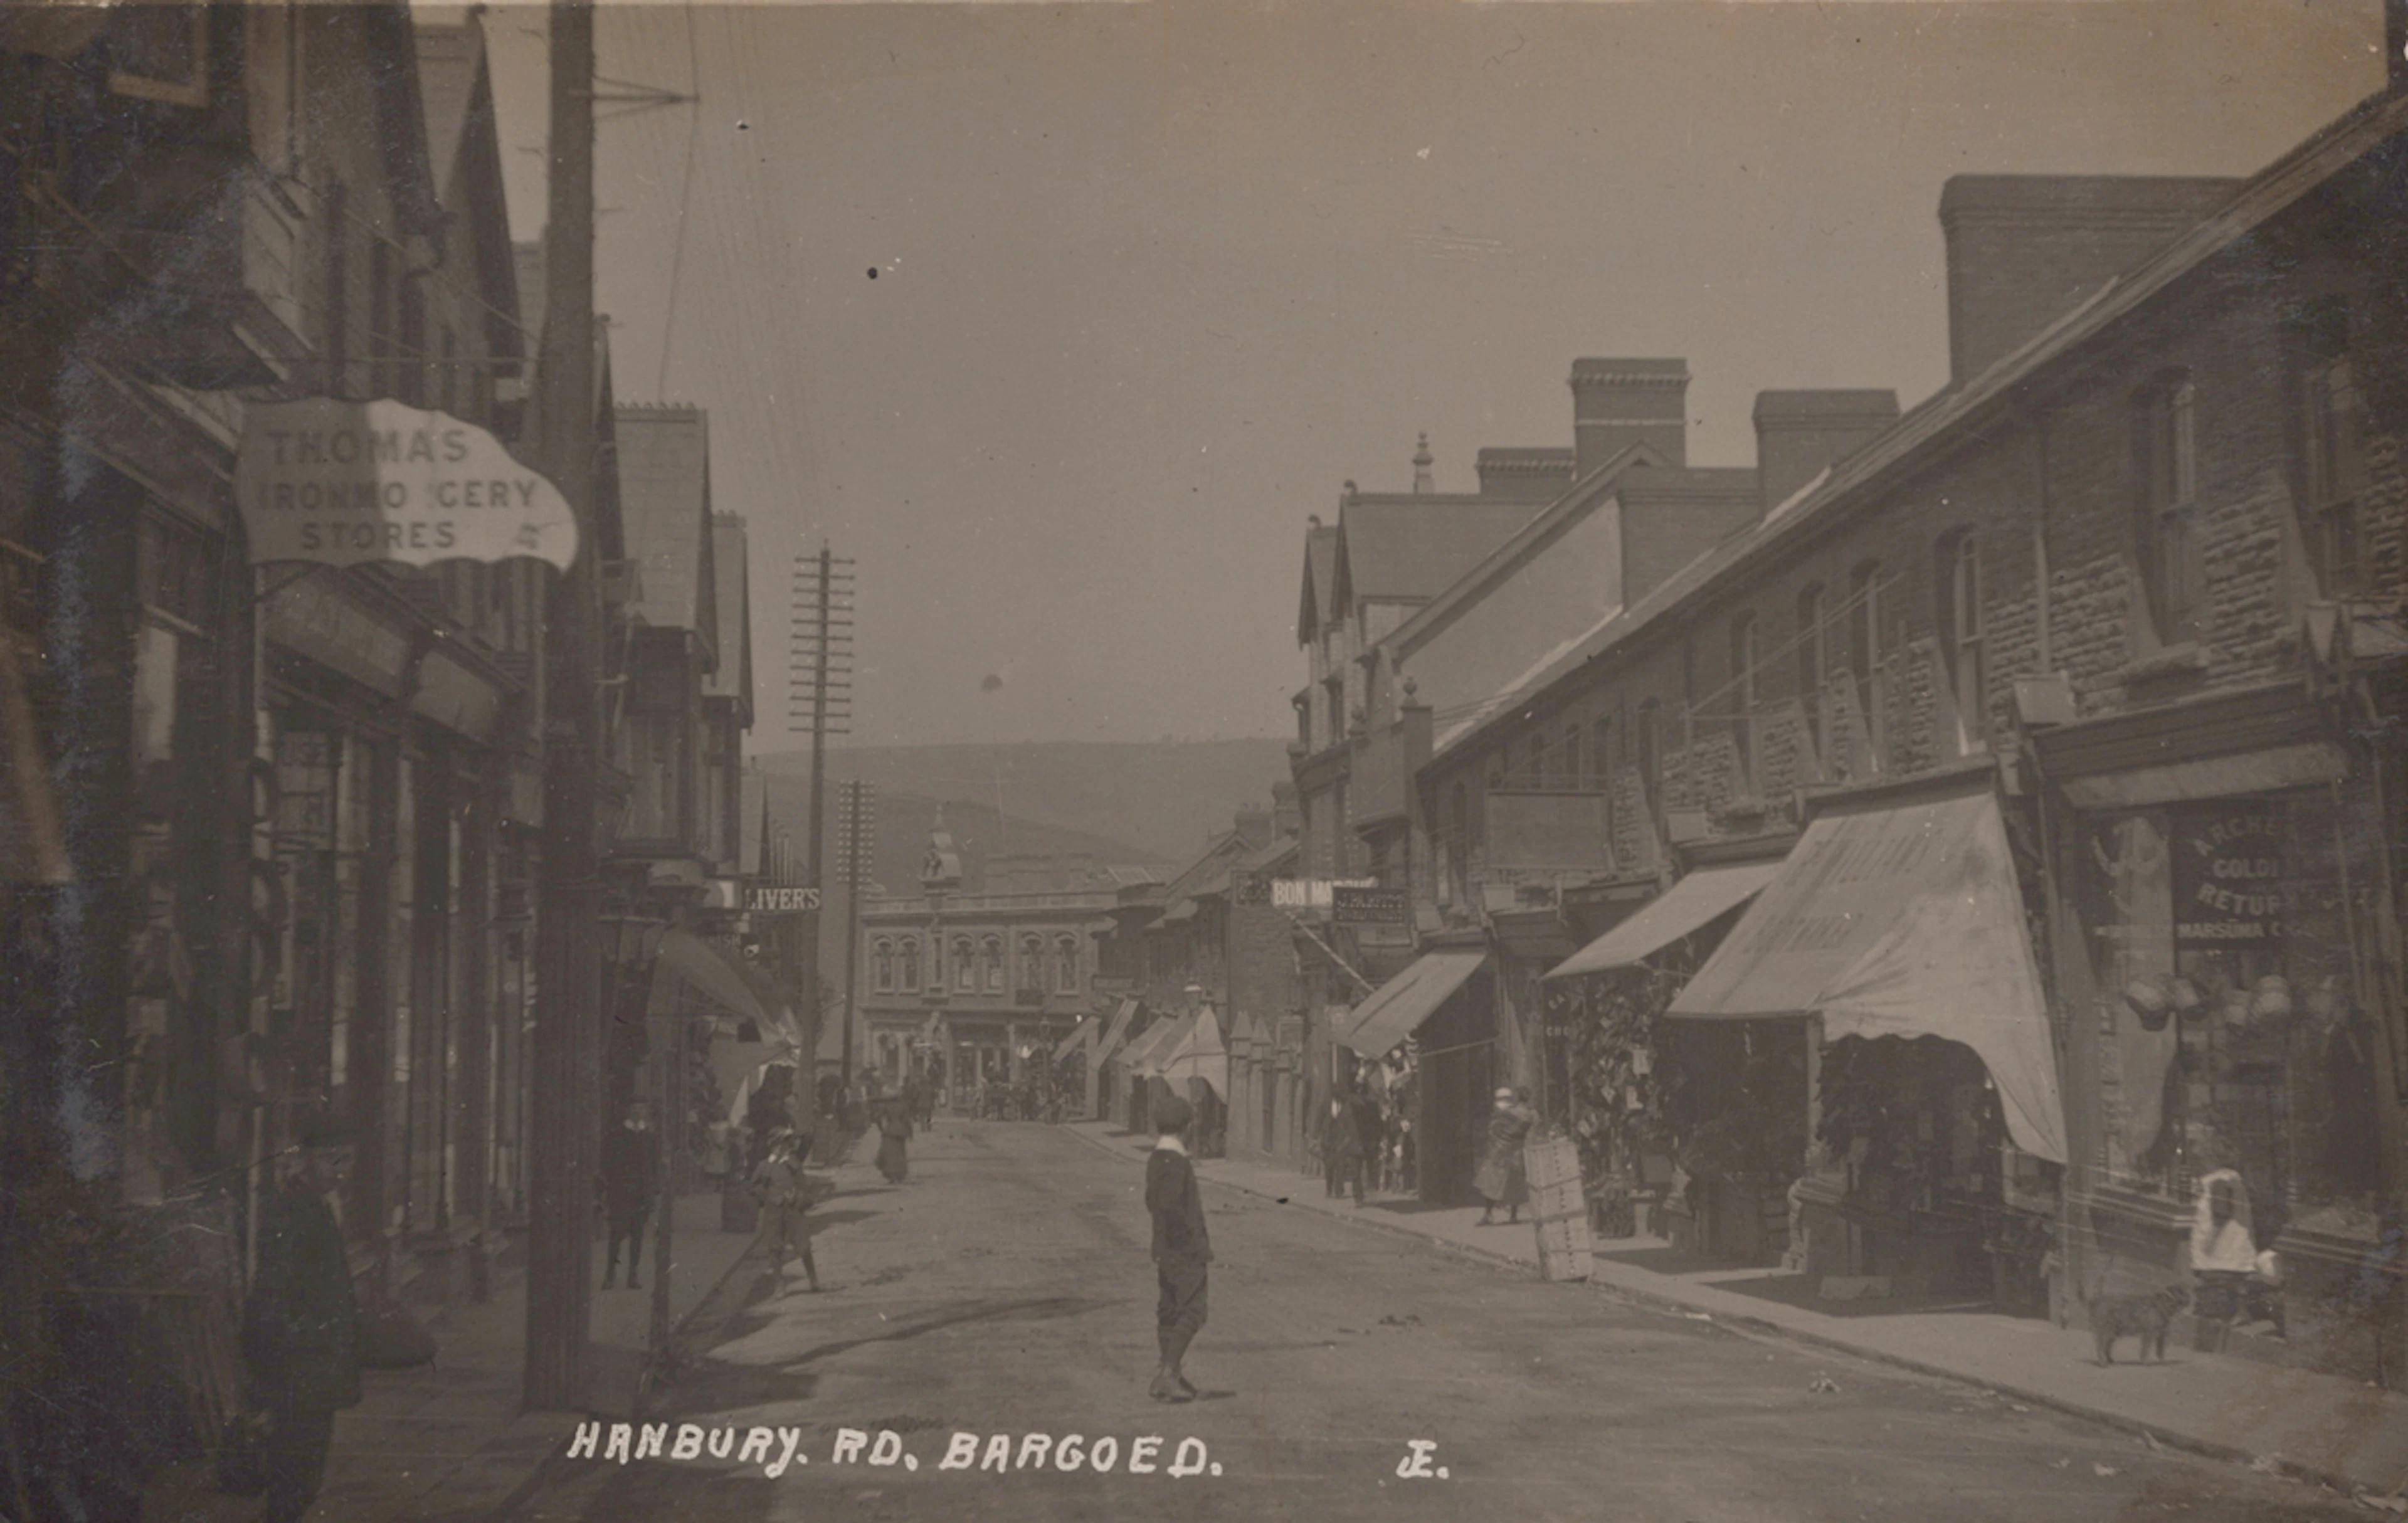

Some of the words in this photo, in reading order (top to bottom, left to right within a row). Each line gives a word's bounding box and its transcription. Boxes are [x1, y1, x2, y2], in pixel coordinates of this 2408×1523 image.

[265, 428, 470, 465] THOMAS
[256, 478, 538, 510] IRONMOGERY
[300, 520, 459, 551] STORES
[1274, 882, 1305, 904] BON
